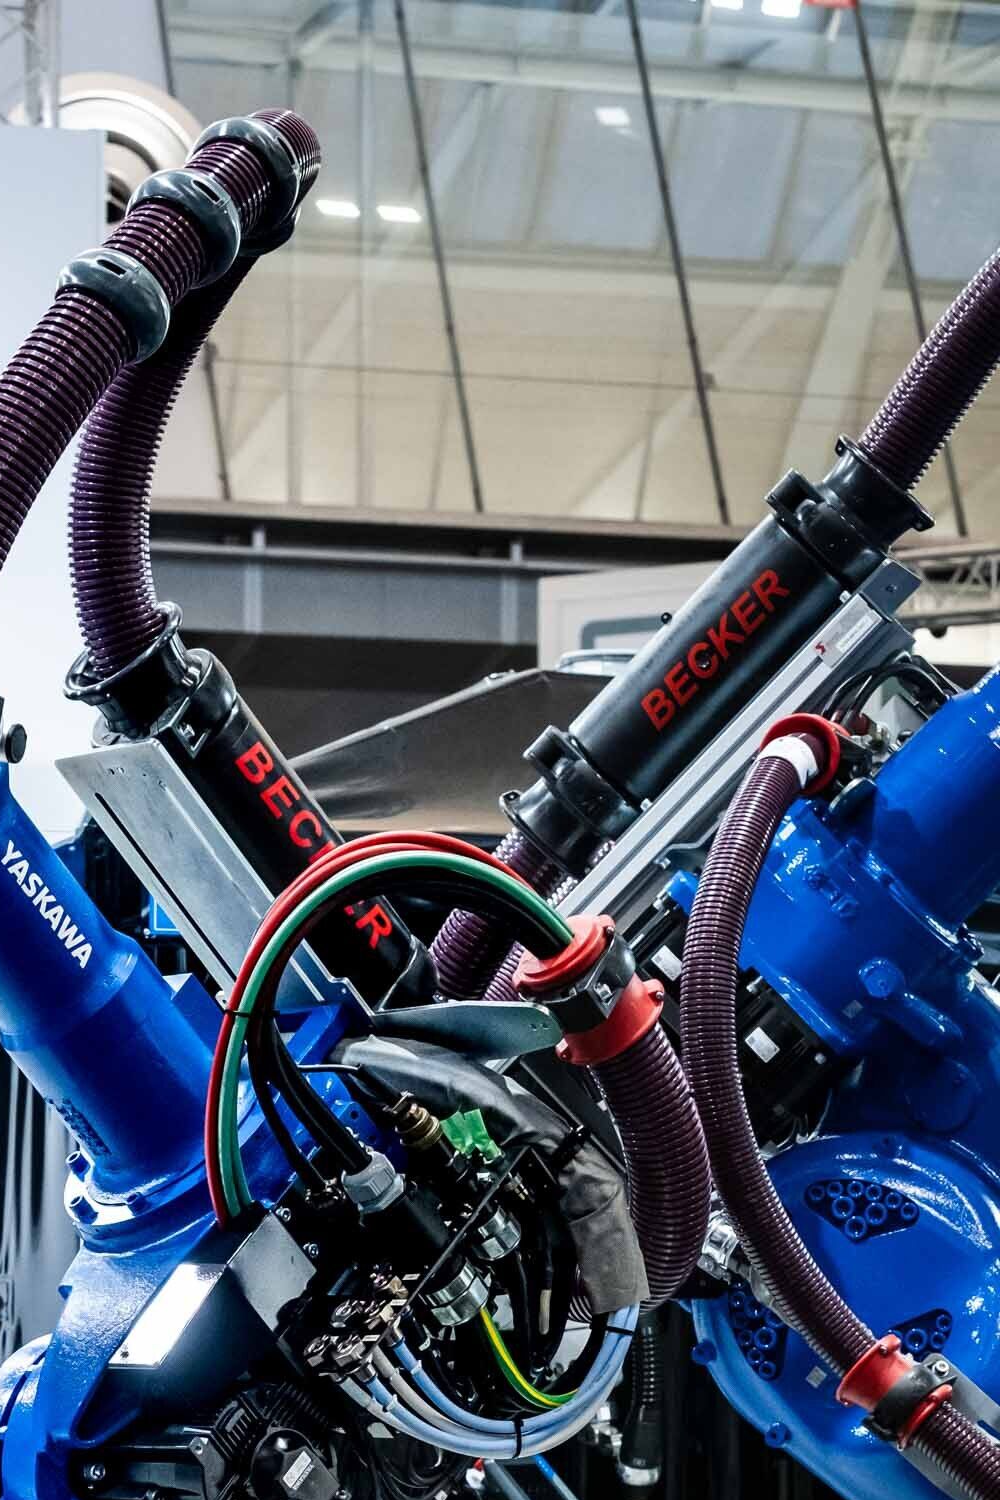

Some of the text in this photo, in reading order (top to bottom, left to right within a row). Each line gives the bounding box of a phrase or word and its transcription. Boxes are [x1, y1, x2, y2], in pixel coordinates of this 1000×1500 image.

[641, 568, 790, 731] BECKER
[1, 840, 92, 968] YASKAWA
[235, 741, 393, 949] BECR
